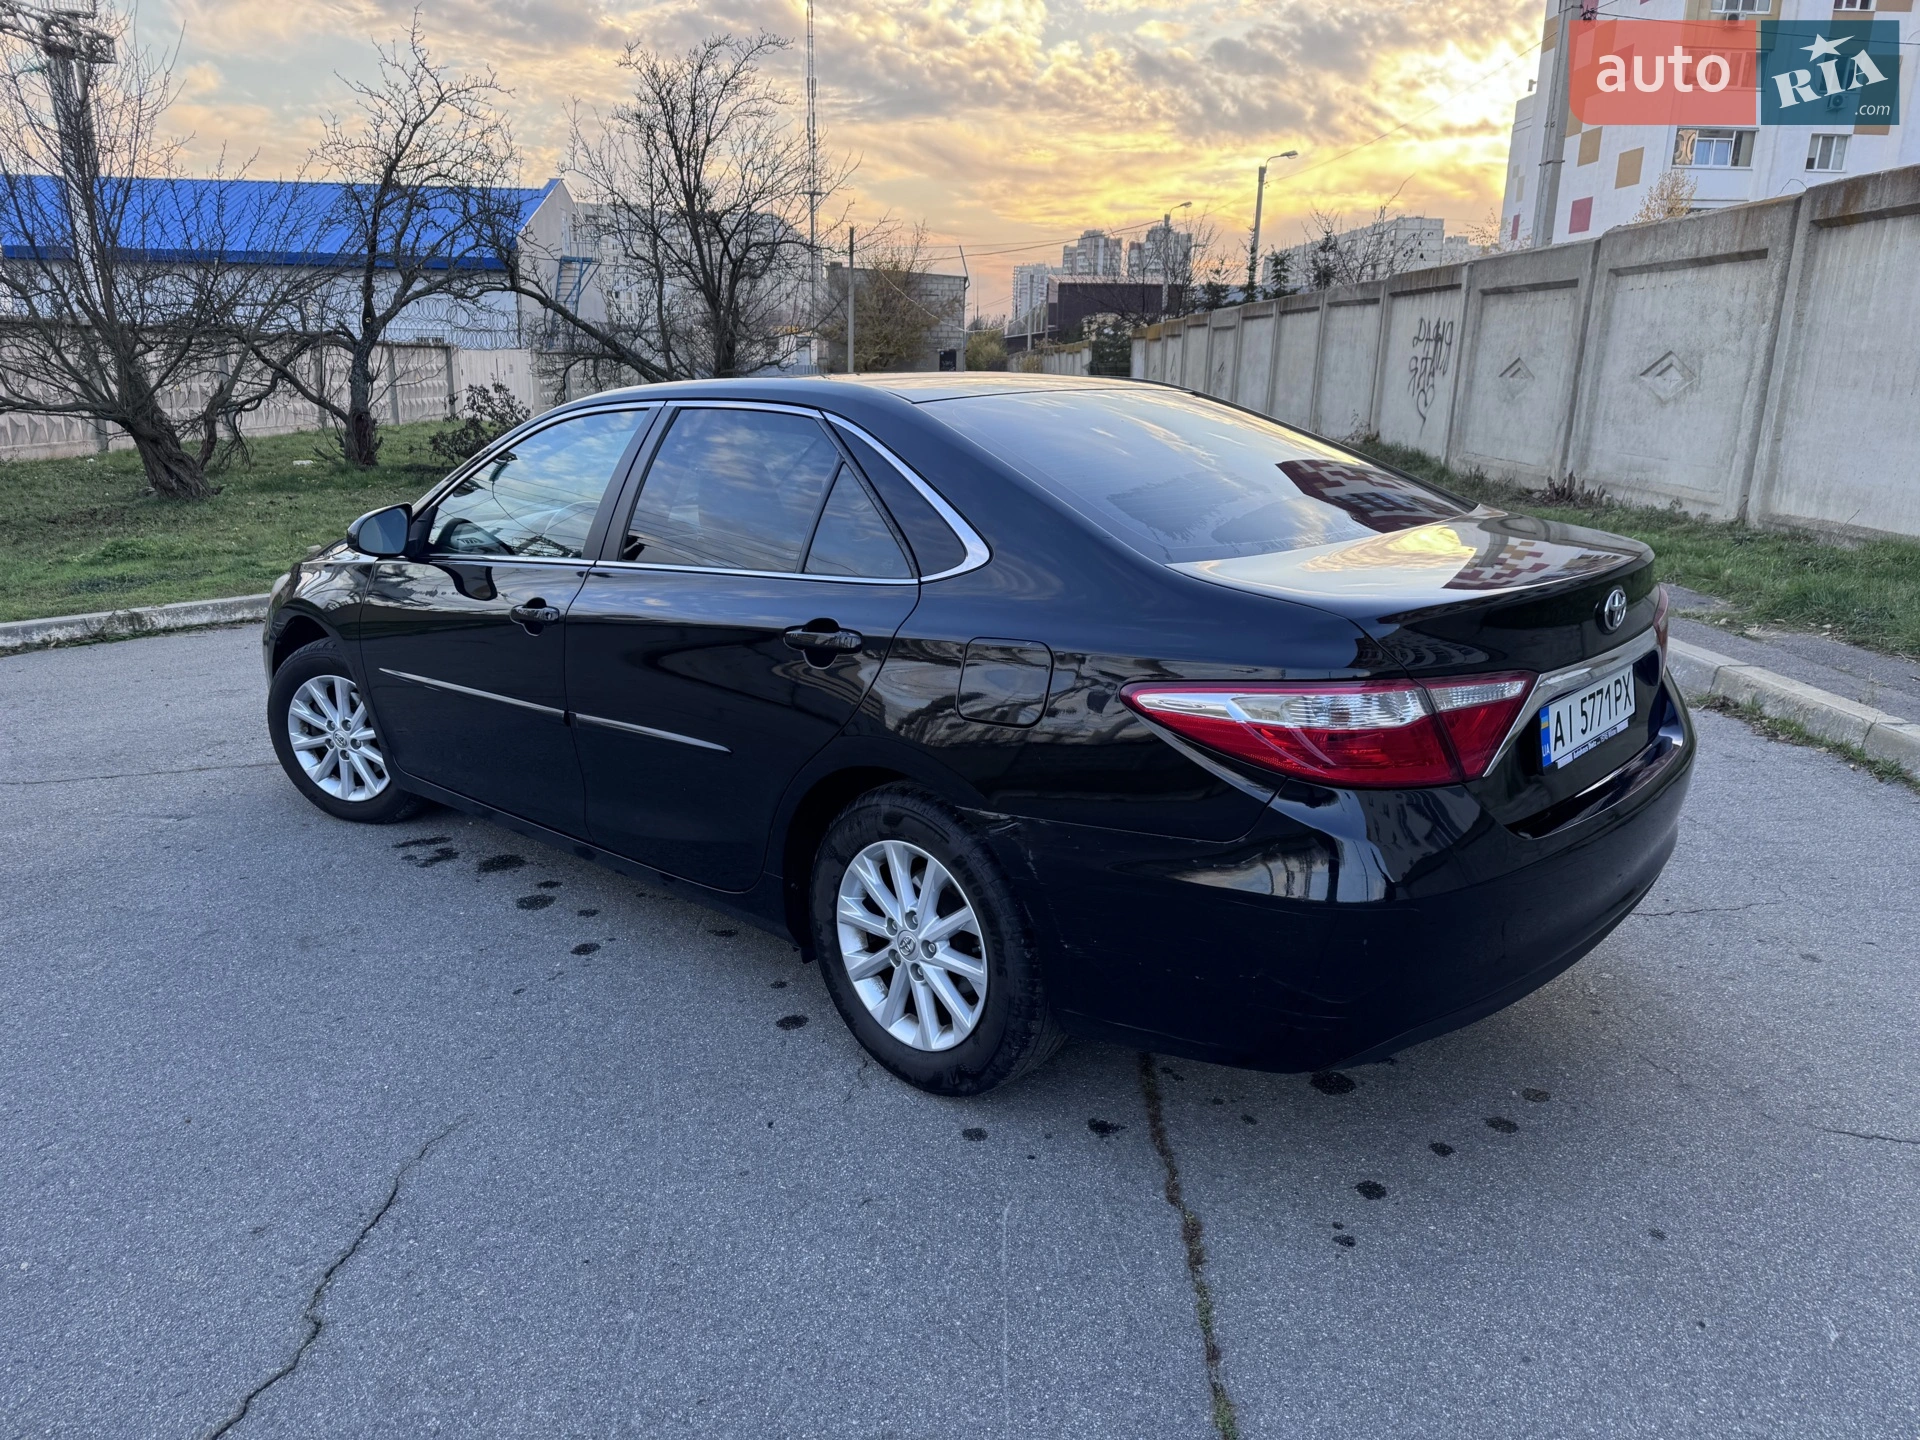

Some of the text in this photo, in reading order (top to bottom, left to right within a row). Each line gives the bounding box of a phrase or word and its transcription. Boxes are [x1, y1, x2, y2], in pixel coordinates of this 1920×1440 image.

[1553, 704, 1572, 752] AI
[1580, 684, 1612, 735] 5771
[1614, 671, 1632, 716] PX
[1541, 743, 1551, 757] UA
